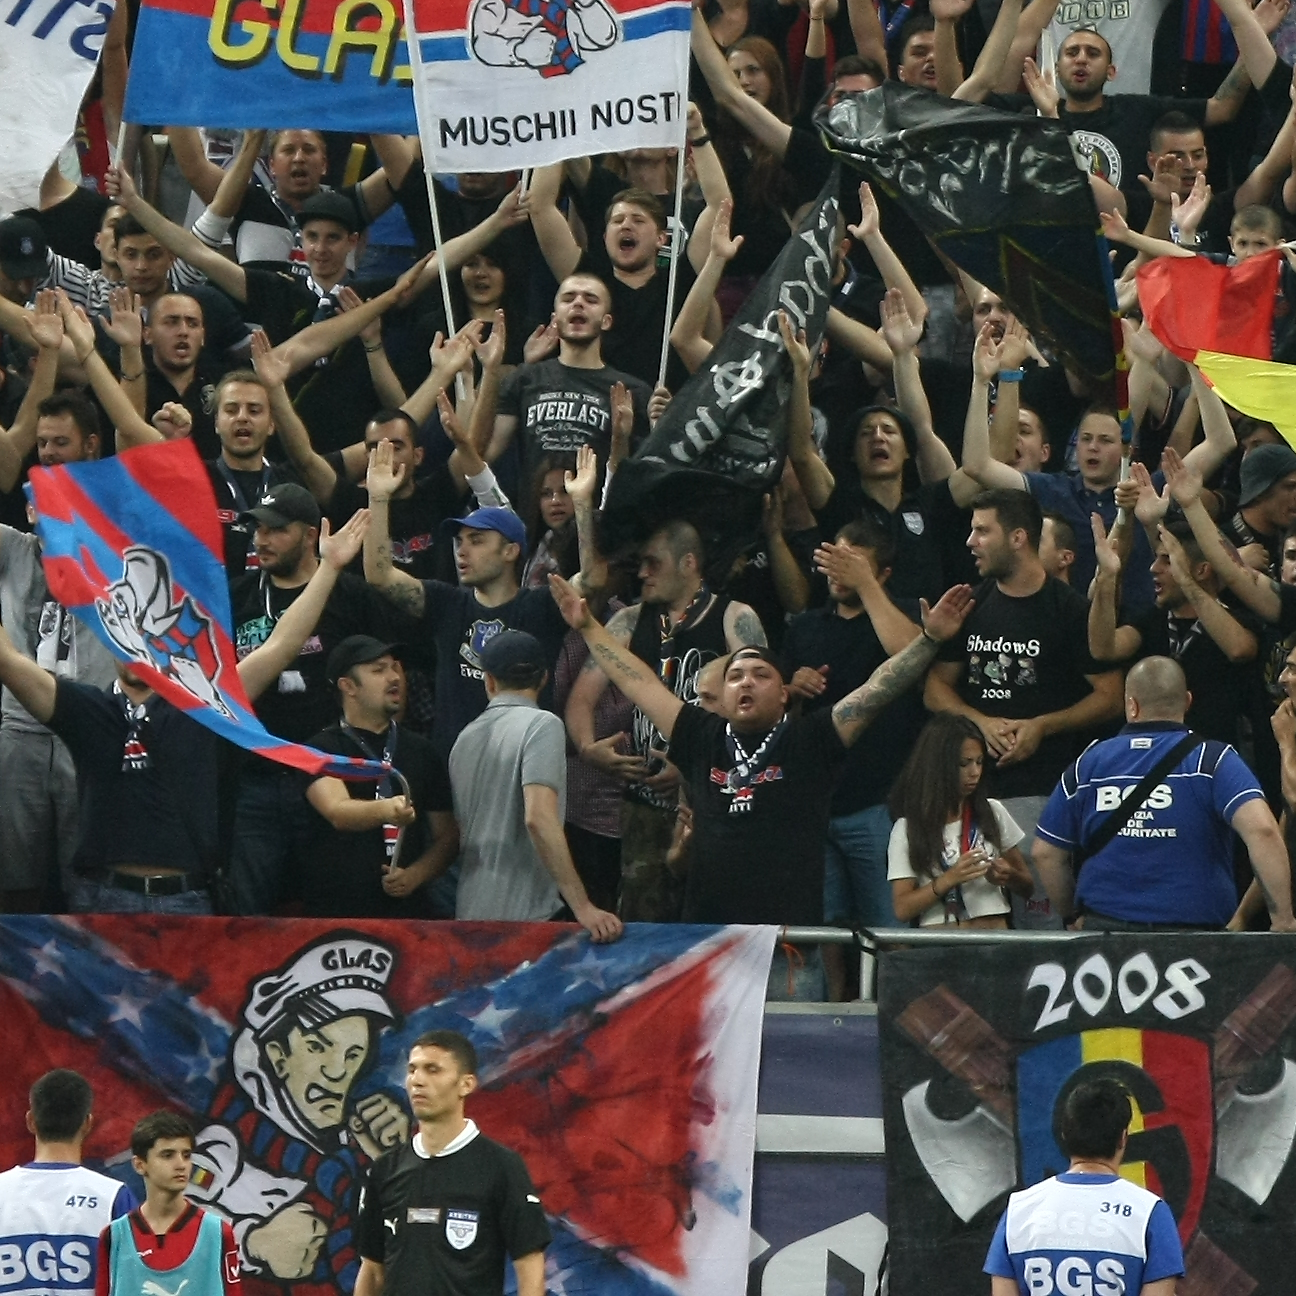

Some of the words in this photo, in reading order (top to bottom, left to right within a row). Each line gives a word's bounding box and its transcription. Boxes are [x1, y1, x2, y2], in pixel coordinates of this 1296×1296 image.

[526, 401, 611, 431] EVERLAST
[981, 688, 1012, 700] 2008
[1126, 818, 1145, 829] DE
[321, 946, 392, 976] GLAS
[1025, 950, 1212, 1034] 2008
[64, 1194, 99, 1211] 475
[1099, 1200, 1133, 1218] 318
[1023, 1256, 1127, 1296] BGS
